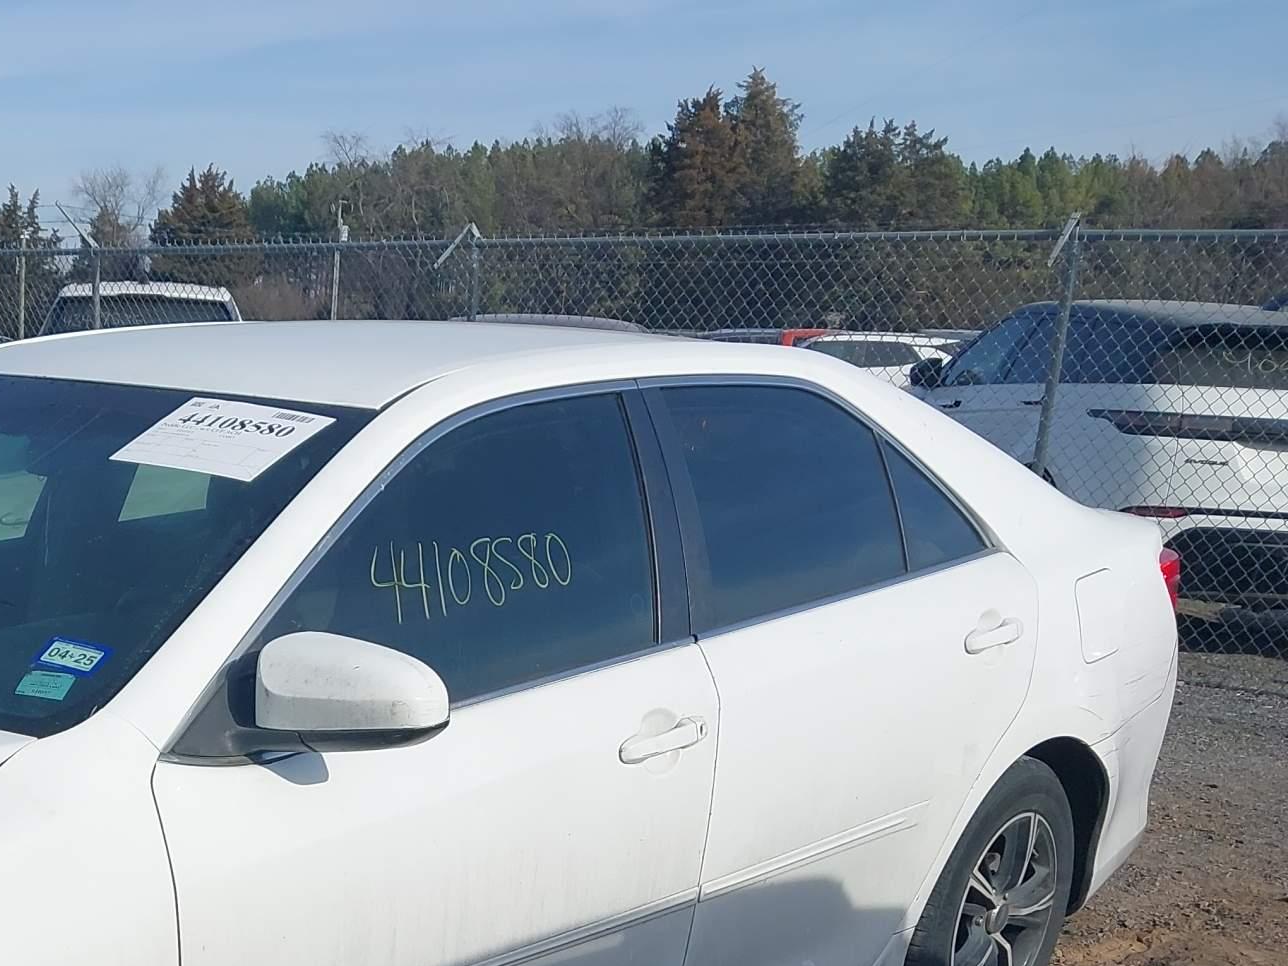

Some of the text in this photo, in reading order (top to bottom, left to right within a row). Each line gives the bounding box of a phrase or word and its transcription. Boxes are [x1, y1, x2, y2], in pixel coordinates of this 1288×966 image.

[179, 412, 296, 438] 44108580
[370, 532, 572, 624] 44108580
[48, 648, 97, 666] 04 25
